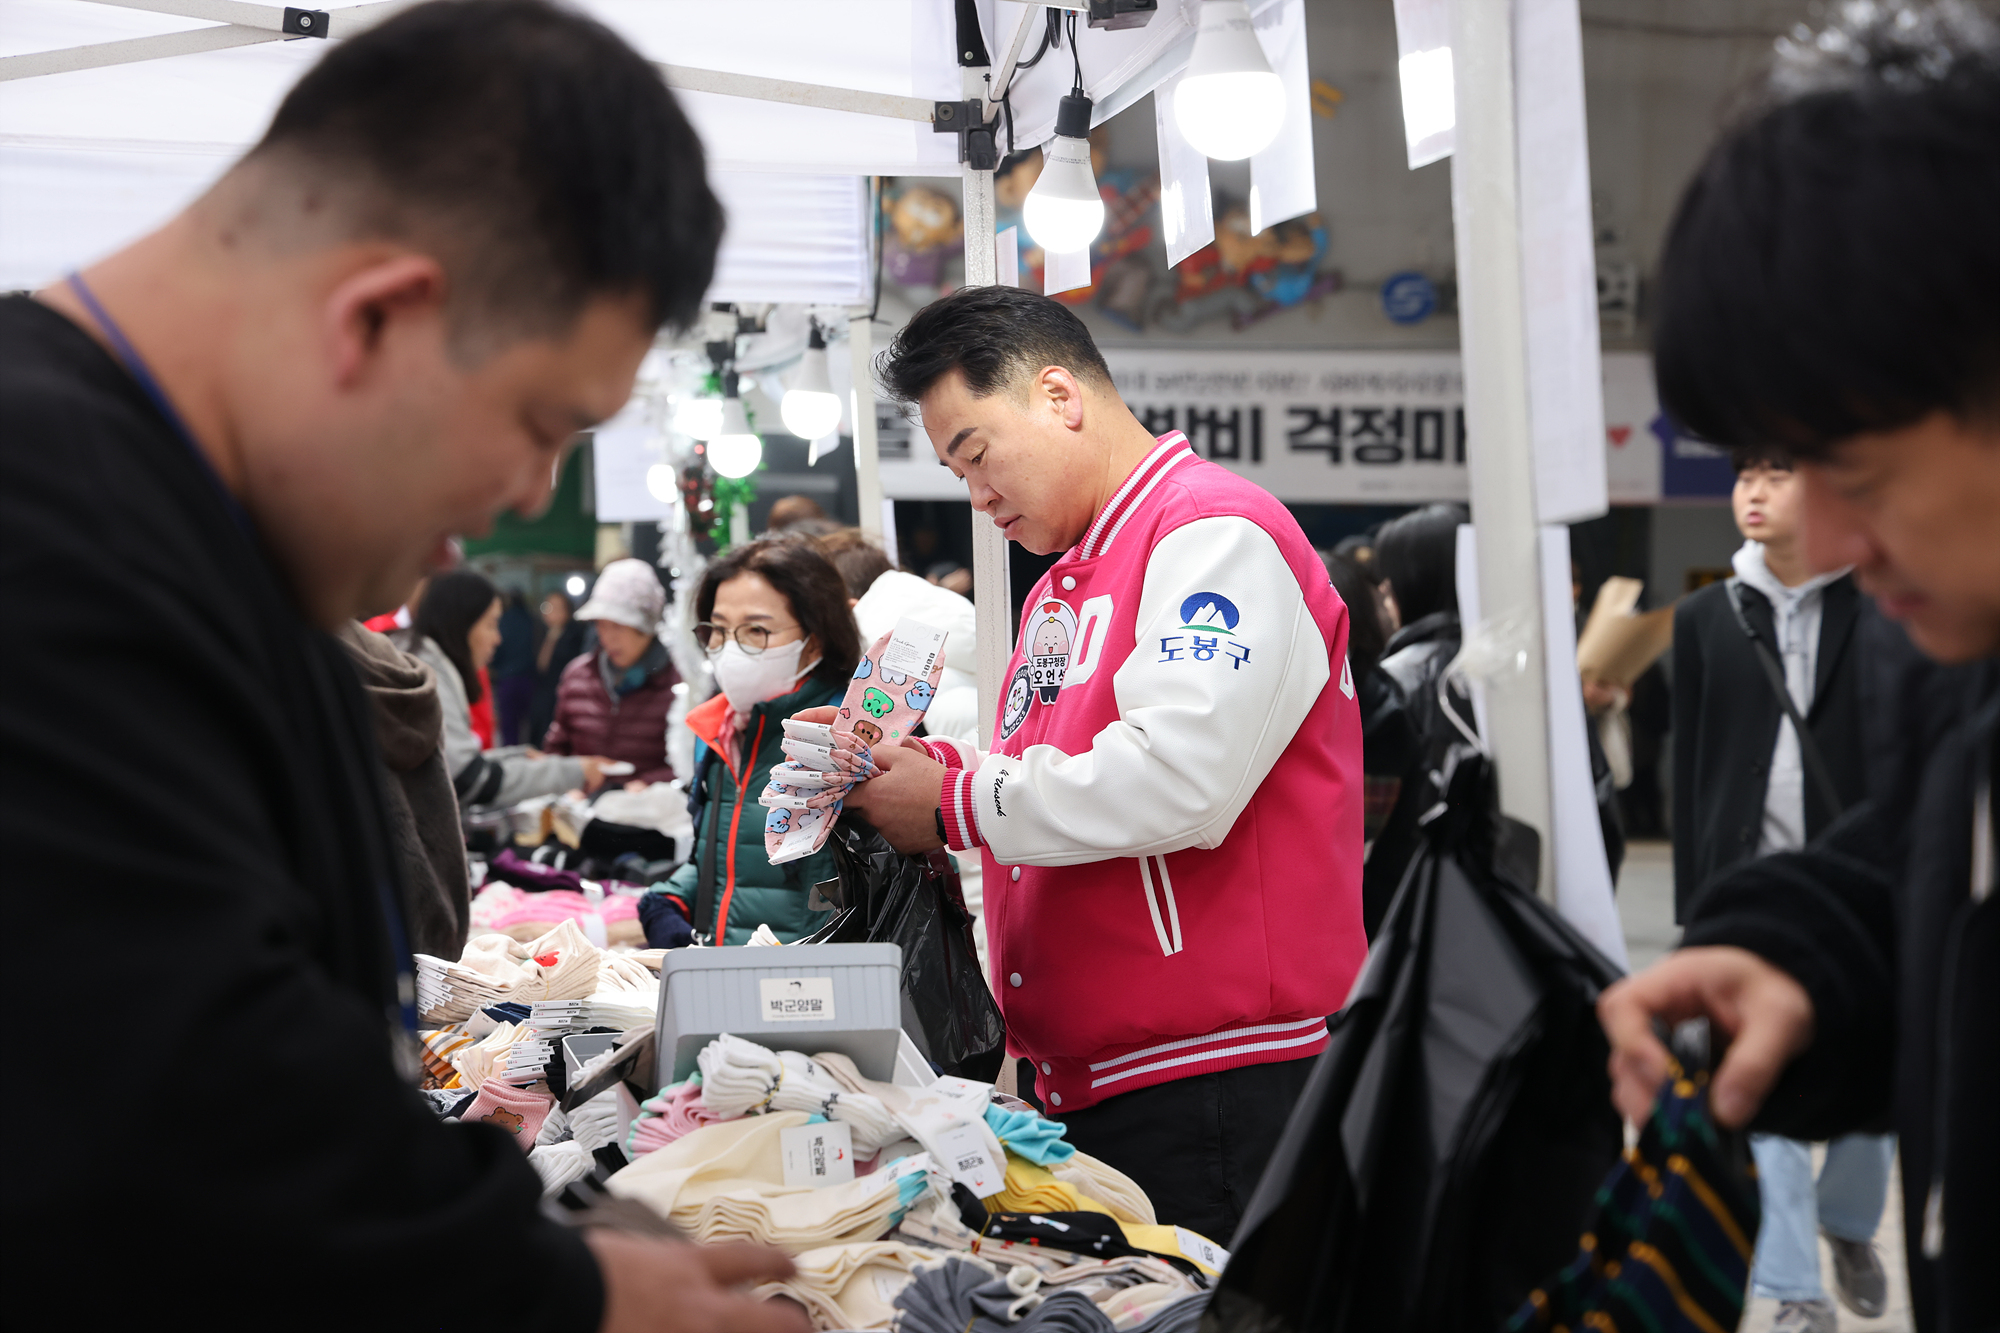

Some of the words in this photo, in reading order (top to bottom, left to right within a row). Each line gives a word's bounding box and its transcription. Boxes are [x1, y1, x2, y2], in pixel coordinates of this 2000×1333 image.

[1061, 594, 1114, 690] D
[1158, 636, 1251, 670] 도봉구
[1036, 657, 1066, 668] 도봉구청장
[770, 998, 823, 1013] 박군양말
